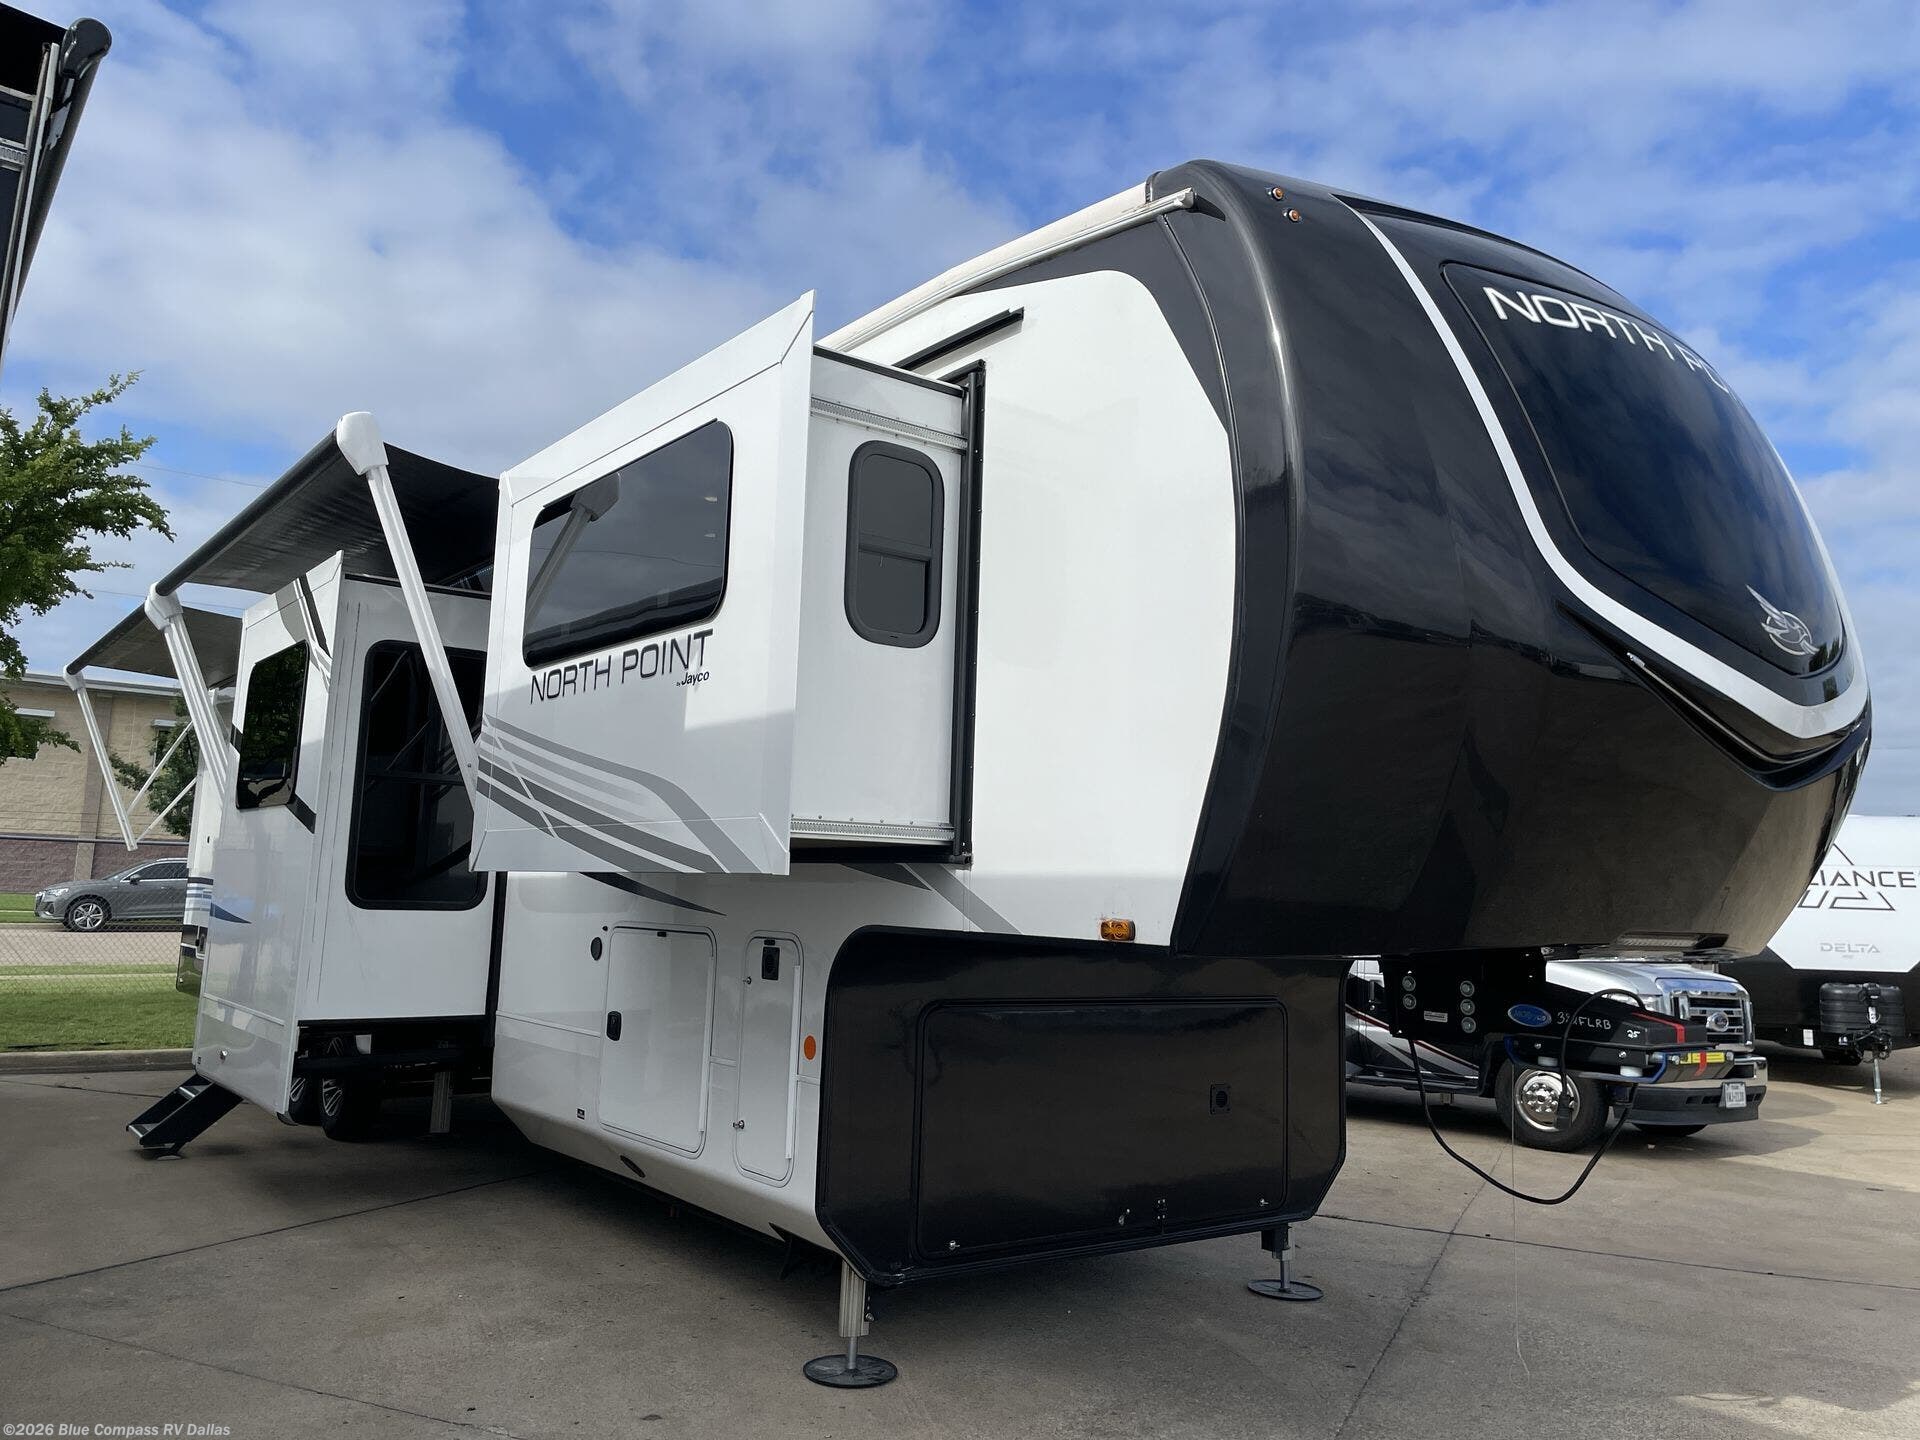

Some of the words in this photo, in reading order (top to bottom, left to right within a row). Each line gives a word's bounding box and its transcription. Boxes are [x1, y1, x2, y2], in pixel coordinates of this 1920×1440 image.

[1483, 286, 1675, 361] NORTH
[530, 654, 612, 705] NORTH
[621, 628, 714, 684] POINT
[681, 671, 710, 686] Jayco
[1810, 869, 1917, 889] IANCE
[1819, 942, 1881, 954] DELTA
